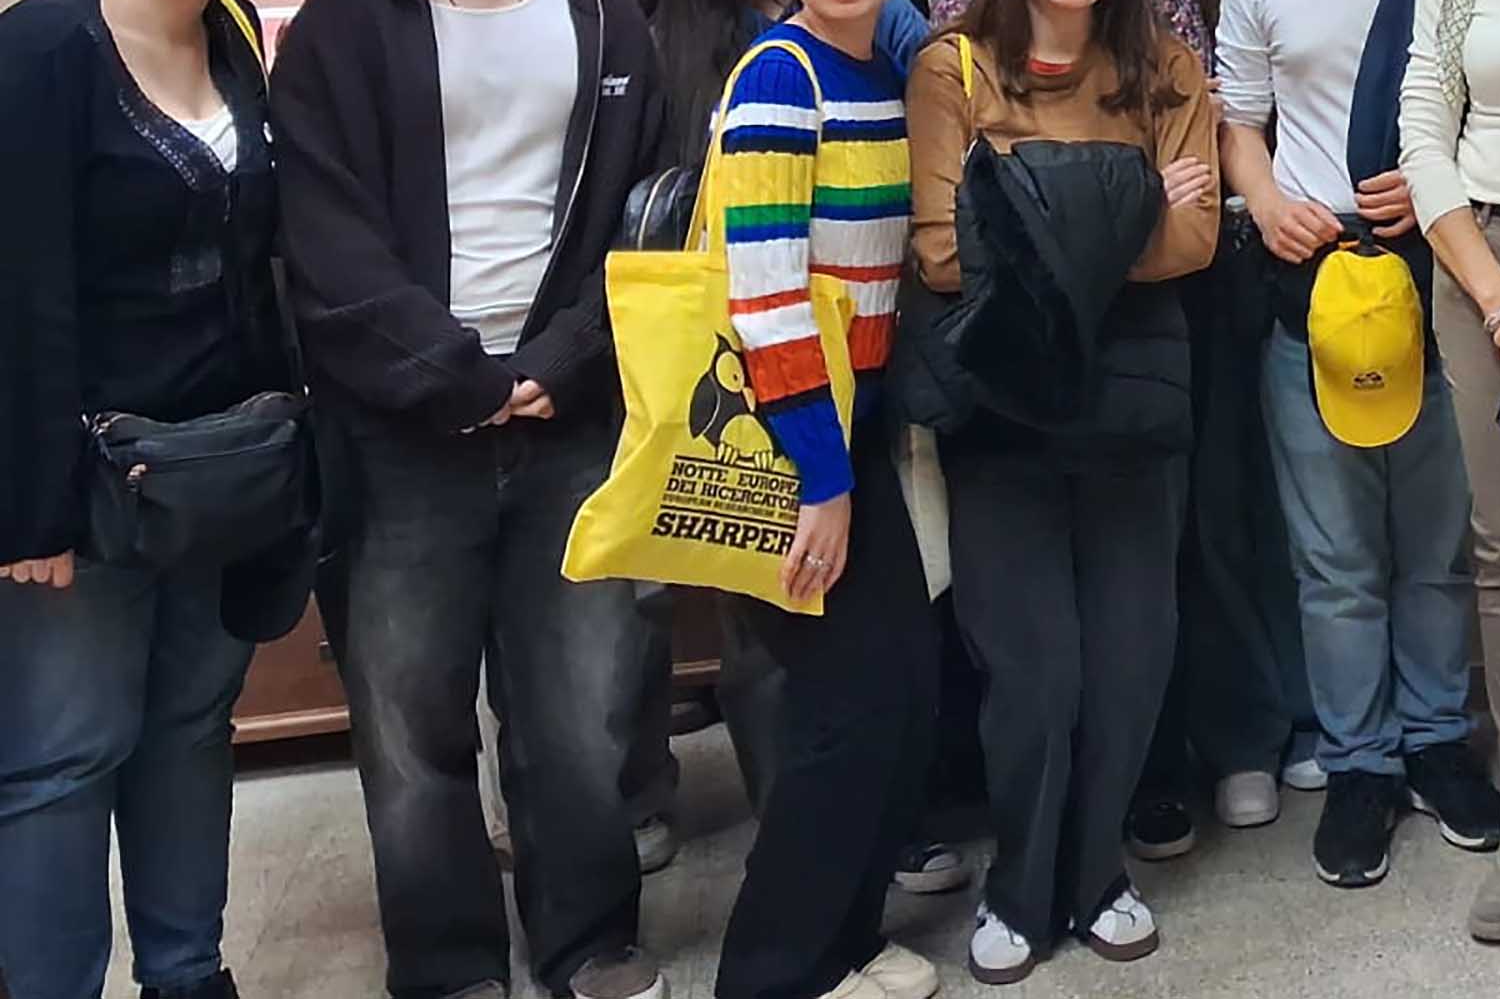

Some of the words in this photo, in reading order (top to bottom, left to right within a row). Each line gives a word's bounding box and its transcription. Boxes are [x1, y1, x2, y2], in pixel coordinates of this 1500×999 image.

[672, 462, 728, 482] NOTTE
[666, 478, 697, 494] DEI
[701, 483, 800, 513] RICERCATOR
[651, 511, 796, 555] SHARPER
